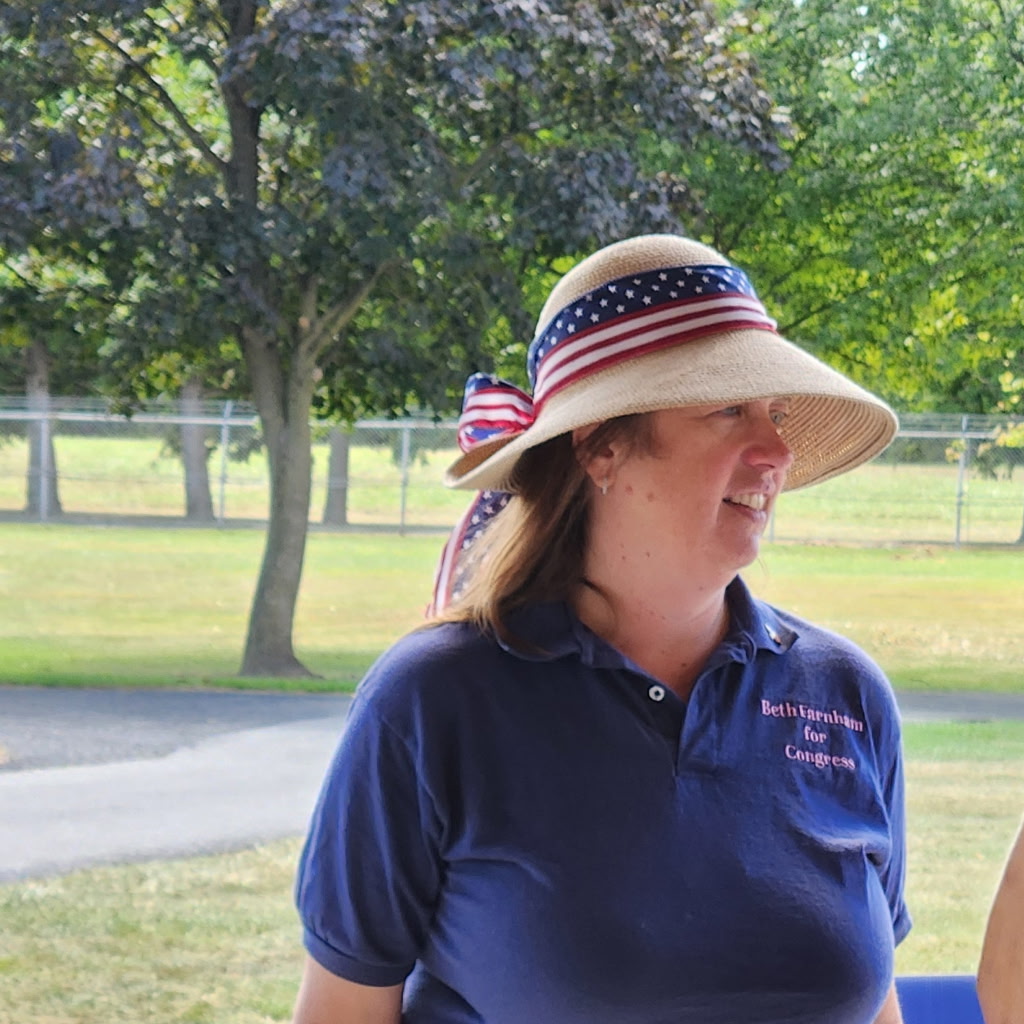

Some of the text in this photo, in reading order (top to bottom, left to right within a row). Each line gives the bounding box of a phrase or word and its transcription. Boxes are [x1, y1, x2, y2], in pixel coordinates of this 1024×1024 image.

[761, 699, 864, 732] Beth Farnham
[804, 726, 827, 743] for
[785, 745, 856, 769] Congress
